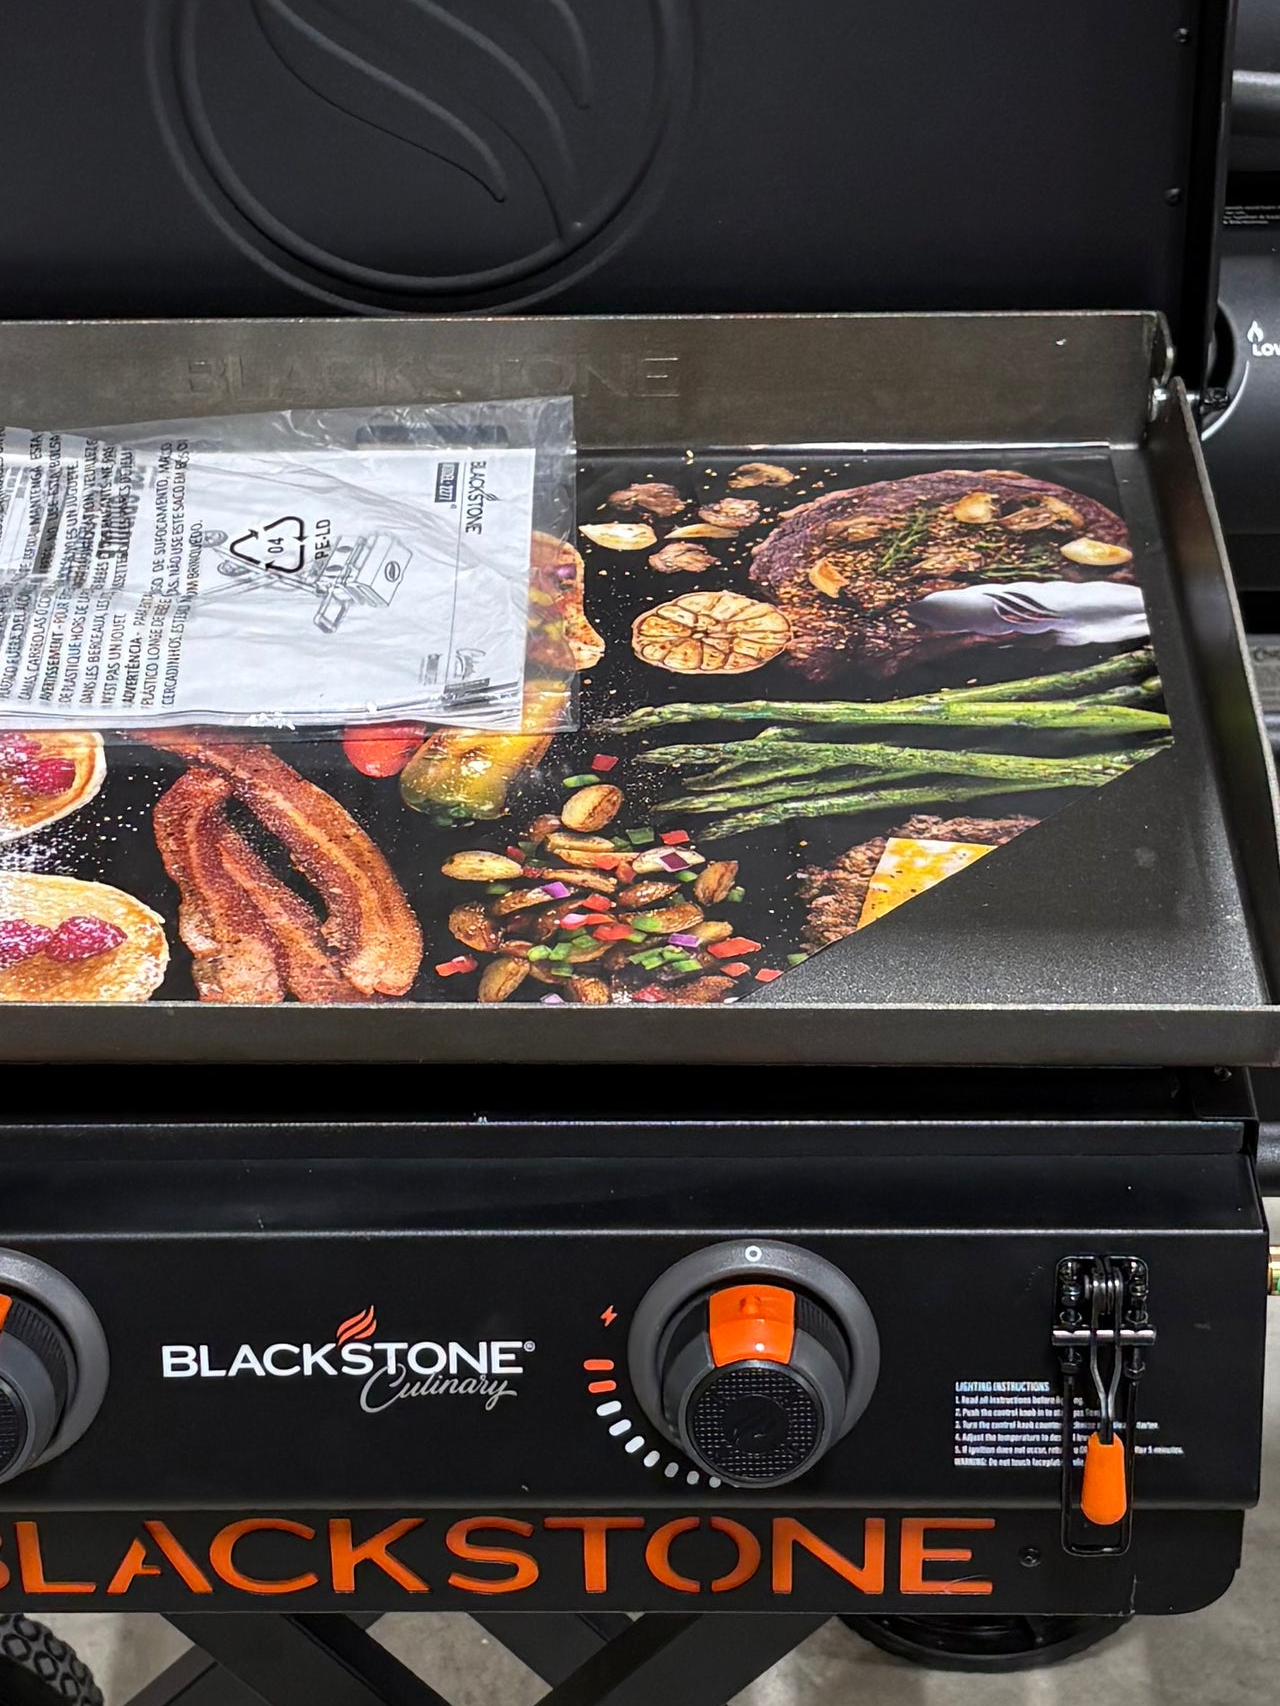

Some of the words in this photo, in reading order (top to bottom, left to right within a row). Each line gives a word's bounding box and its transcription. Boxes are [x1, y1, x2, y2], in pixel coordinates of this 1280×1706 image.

[29, 434, 43, 460] ESTA
[29, 465, 42, 525] MANTENGA
[173, 485, 185, 511] SACO
[464, 461, 488, 536] BLACKSTONE
[173, 513, 184, 535] ESTE
[170, 536, 183, 554] USE
[187, 519, 203, 578] BRINQUEDO.
[268, 537, 284, 553] 04
[121, 637, 143, 703] ADVERTÊNCIA
[154, 476, 170, 556] SUFOCAMENTO,
[40, 631, 64, 701] AVERTISSEMENT
[62, 642, 81, 692] PLASTIQUE
[108, 644, 122, 660] UN
[85, 665, 100, 681] LES
[106, 662, 121, 681] PAS
[140, 663, 159, 705] PLÁSTICO
[161, 1340, 524, 1378] BLACKSTONE
[359, 1361, 519, 1414] Culinary
[956, 1382, 992, 1392] LIGHTING
[993, 1382, 1050, 1391] INSTRUCTIONS
